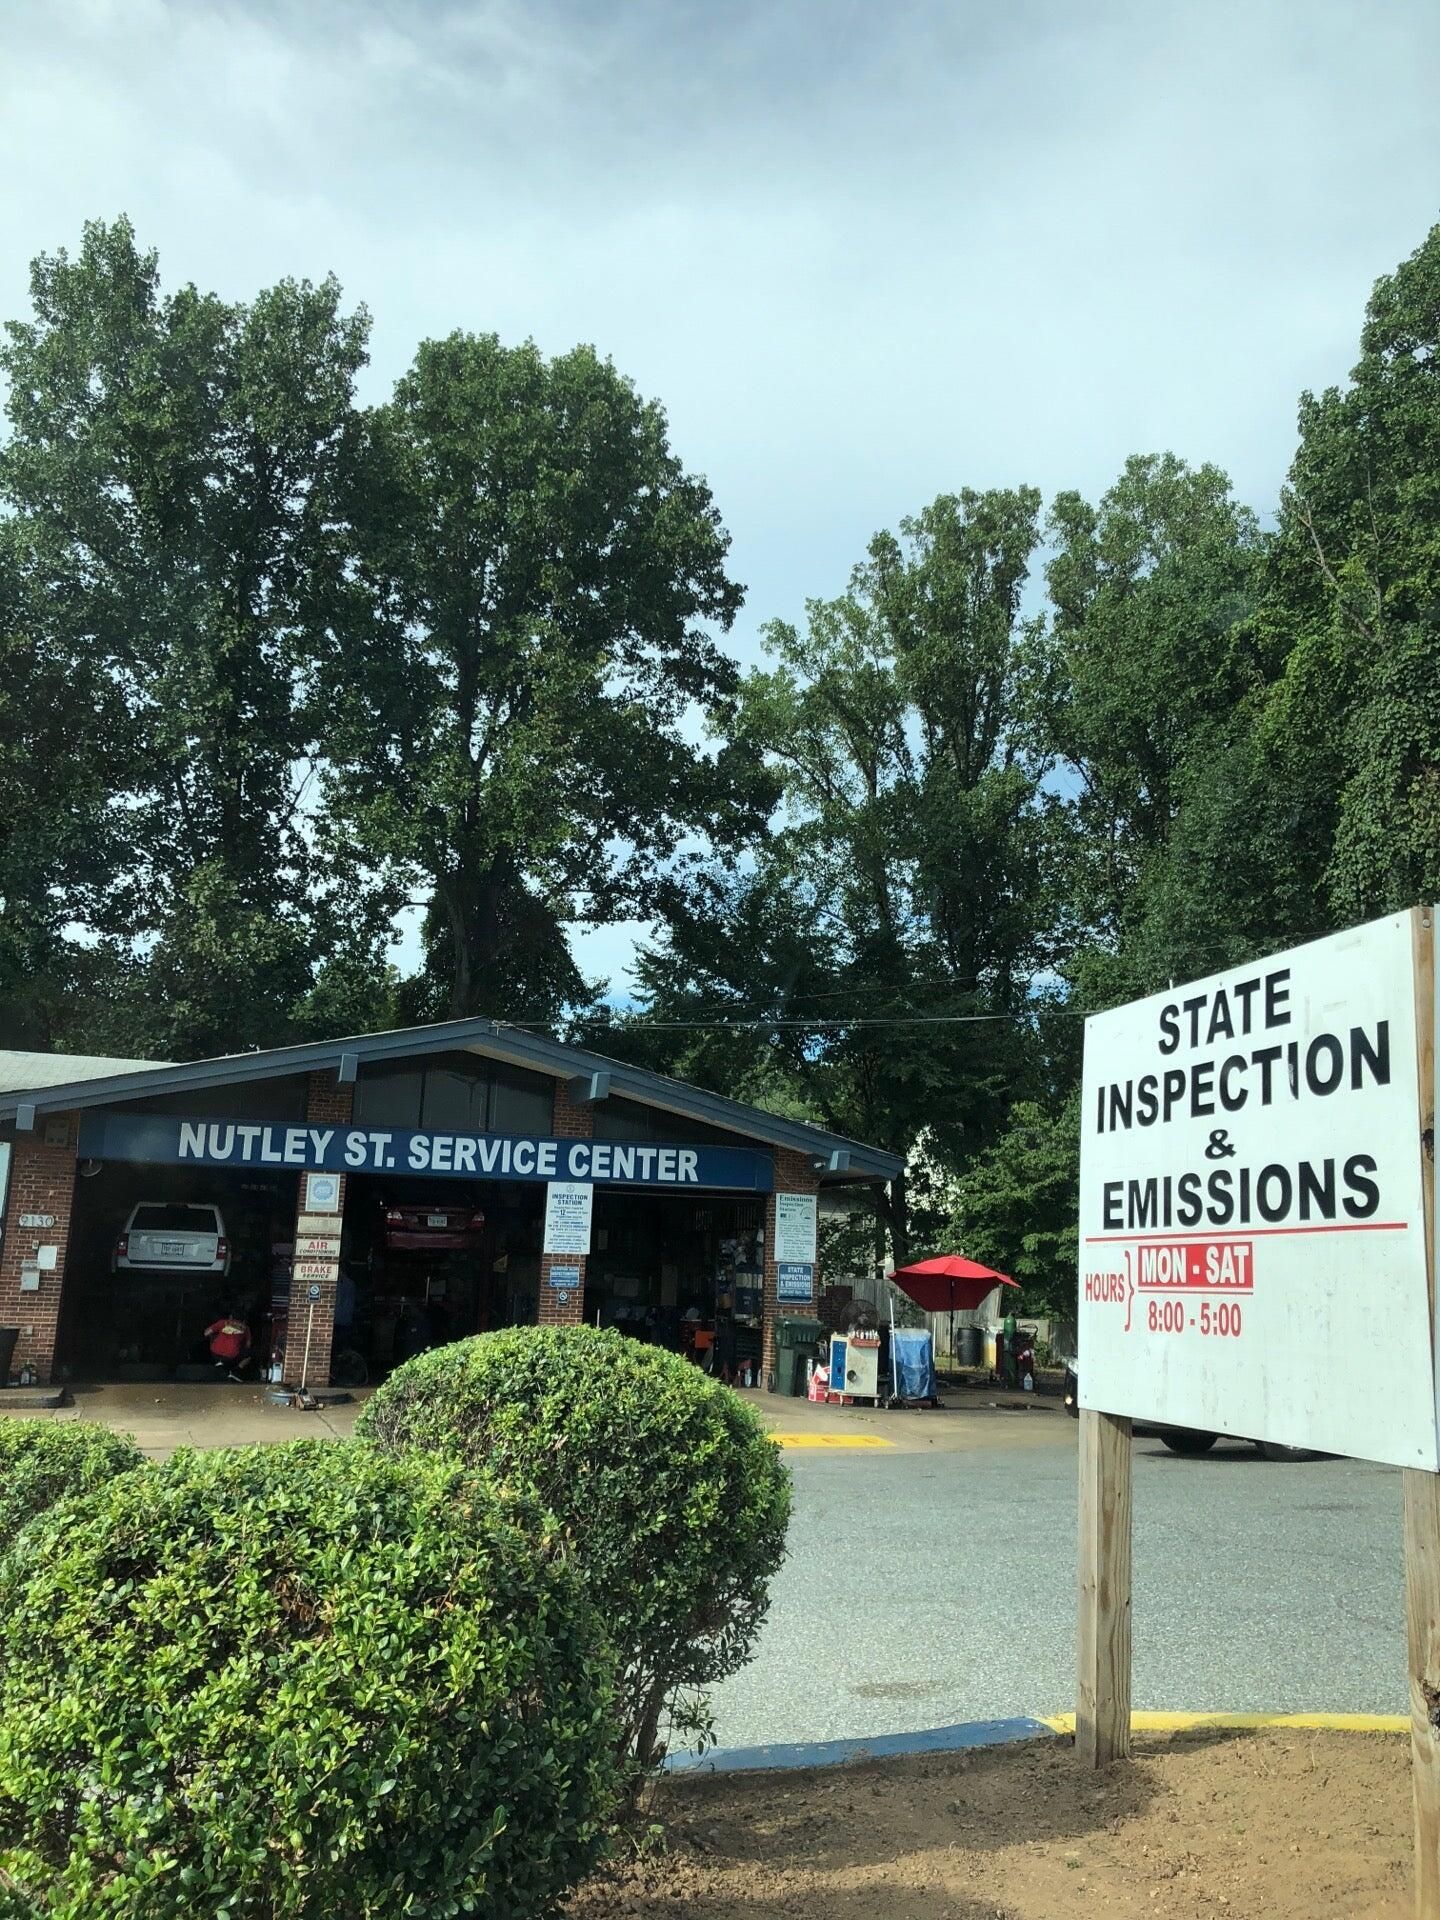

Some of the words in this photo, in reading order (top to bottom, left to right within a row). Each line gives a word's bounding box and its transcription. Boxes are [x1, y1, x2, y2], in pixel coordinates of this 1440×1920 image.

[1157, 968, 1291, 1056] STATE
[1096, 1020, 1391, 1134] INSPECTION
[178, 1122, 335, 1165] NUTLEY
[344, 1131, 396, 1168] ST.
[407, 1135, 558, 1176] SERVICE
[568, 1144, 699, 1182] CENTER
[1204, 1129, 1236, 1160] &
[779, 1195, 813, 1203] Emissions
[1102, 1154, 1380, 1231] EMISSIONS
[20, 1216, 54, 1227] 9130
[309, 1241, 328, 1249] AIR
[779, 1273, 811, 1281] INSPECTION
[787, 1266, 804, 1274] STATE
[1140, 1247, 1187, 1285] MON
[1205, 1245, 1250, 1286] SAT
[1085, 1272, 1126, 1304] HOURS
[1147, 1301, 1185, 1334] 8:00
[1200, 1302, 1242, 1337] 5:00
